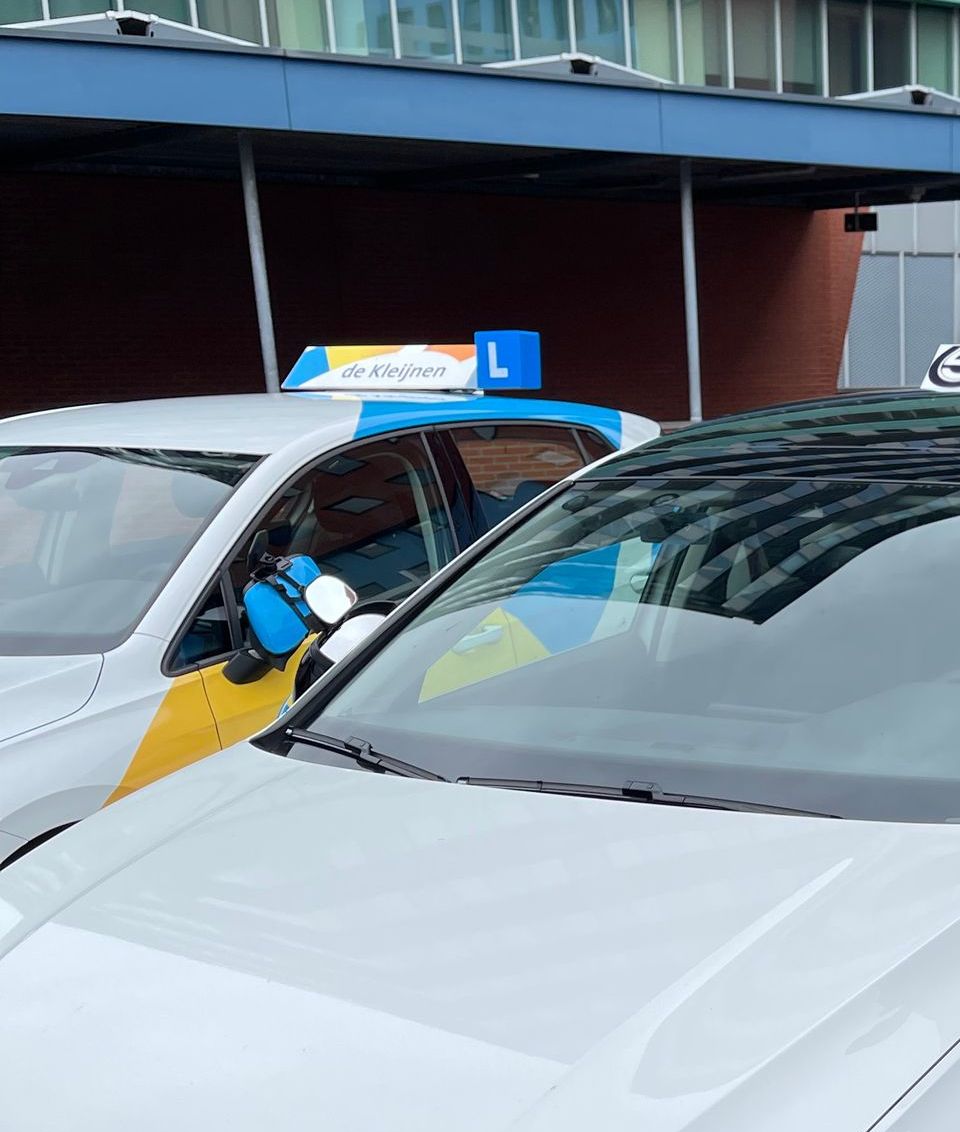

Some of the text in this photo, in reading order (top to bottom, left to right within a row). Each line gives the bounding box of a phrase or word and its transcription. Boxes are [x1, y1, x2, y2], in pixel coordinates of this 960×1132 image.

[341, 364, 447, 382] de Kleijnen
[487, 341, 509, 378] L
